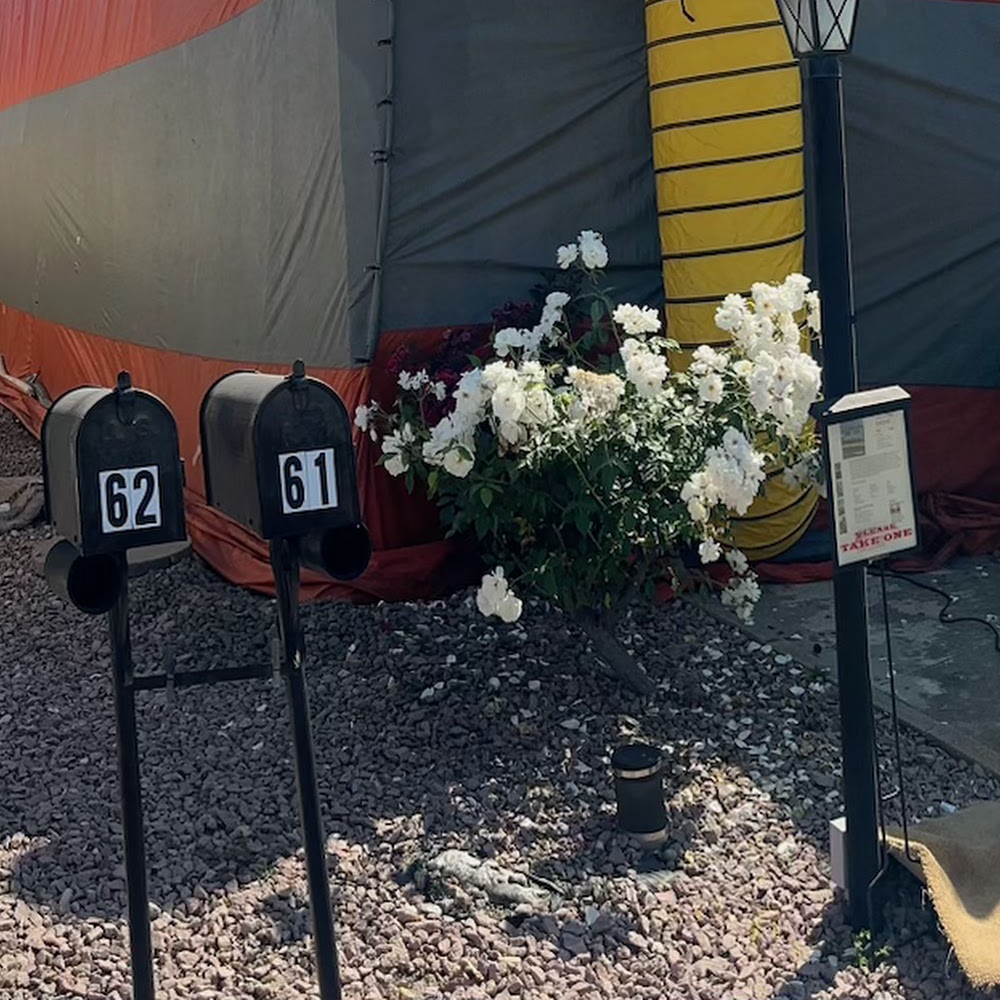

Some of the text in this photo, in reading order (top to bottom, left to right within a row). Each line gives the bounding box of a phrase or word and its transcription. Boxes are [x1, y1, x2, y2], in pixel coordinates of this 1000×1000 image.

[105, 470, 157, 528] 62
[283, 452, 330, 510] 61
[840, 527, 913, 552] TAKE ONE
[855, 523, 897, 539] PLEASE
